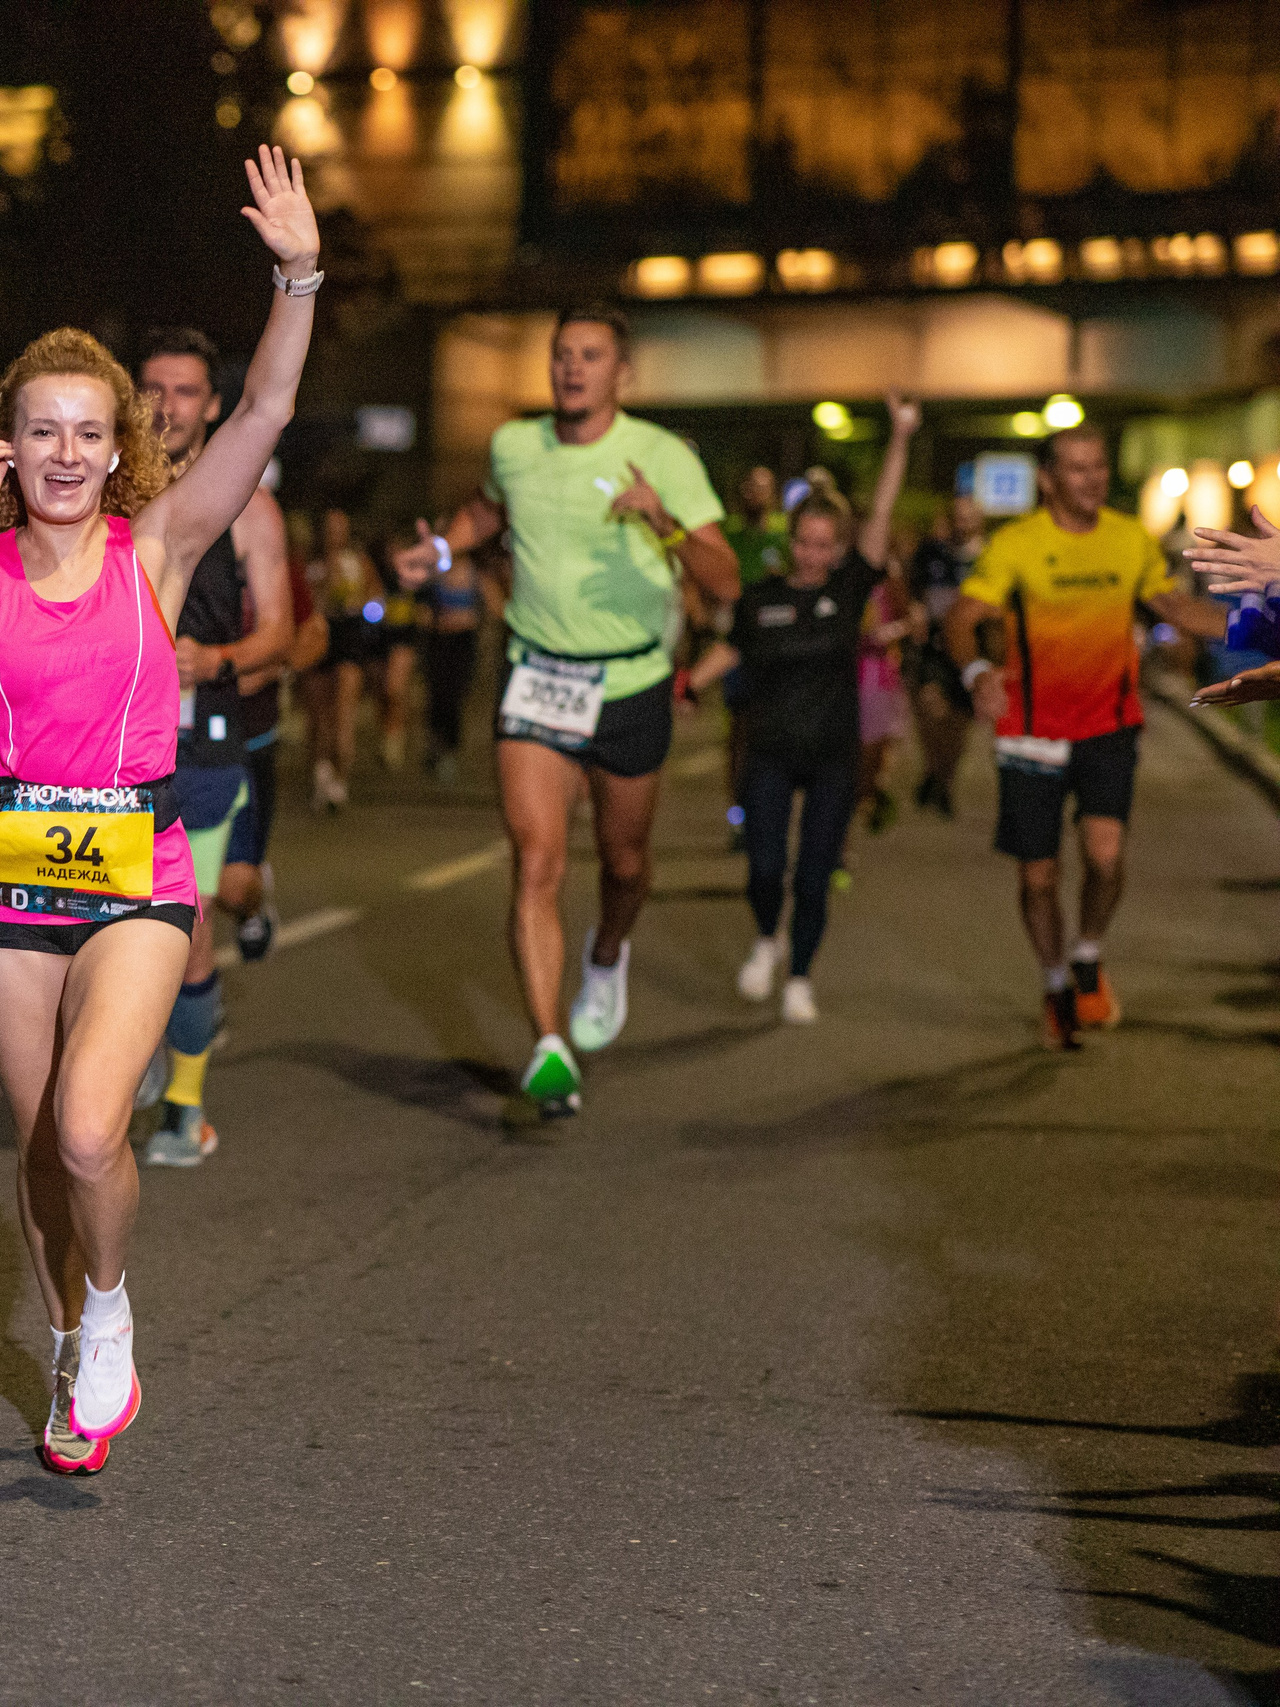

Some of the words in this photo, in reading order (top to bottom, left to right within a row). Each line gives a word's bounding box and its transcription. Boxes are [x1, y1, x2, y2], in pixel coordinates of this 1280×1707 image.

[15, 783, 140, 808] НОЧНОЙ
[45, 825, 104, 866] 34
[36, 866, 111, 885] НАДЕЖДА
[11, 888, 29, 910] D
